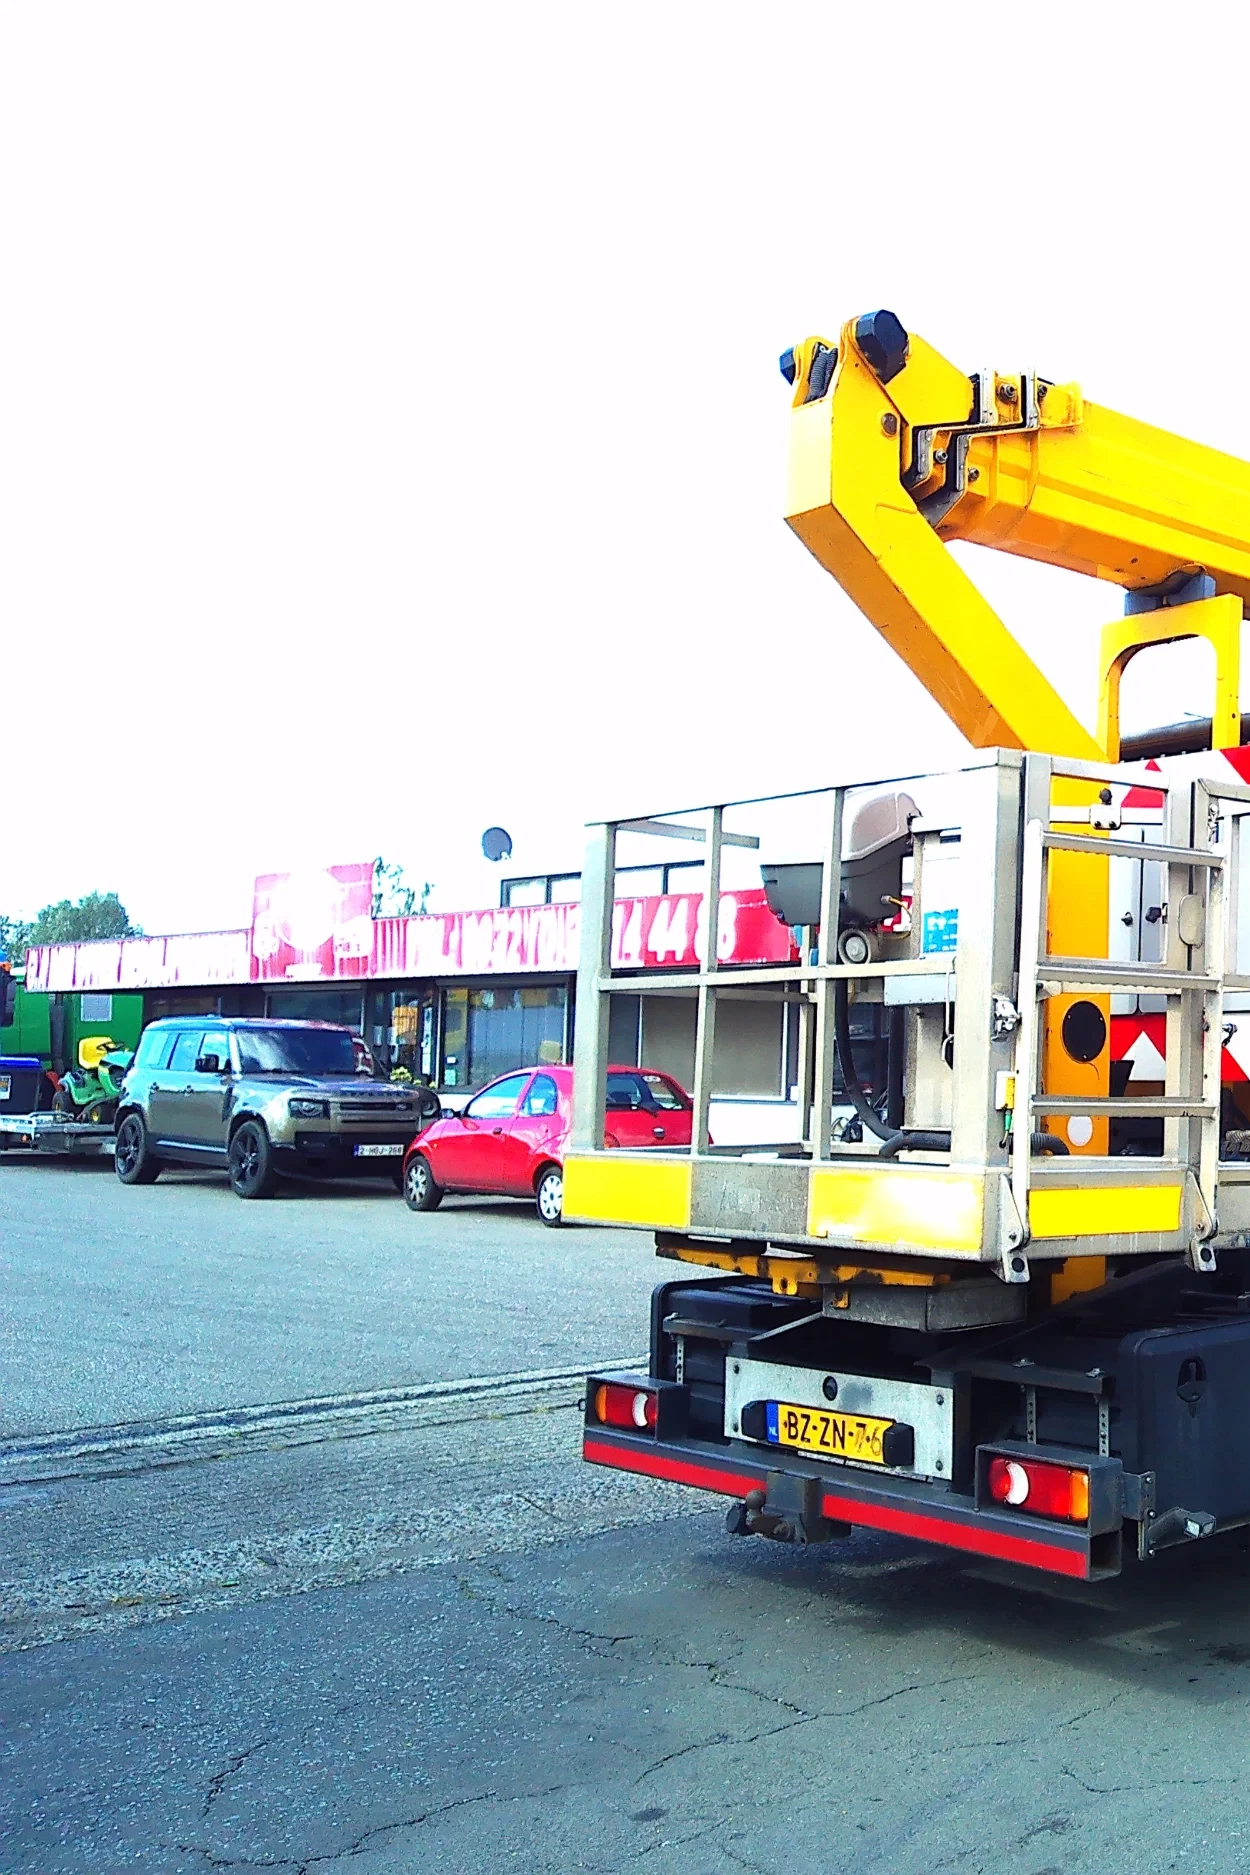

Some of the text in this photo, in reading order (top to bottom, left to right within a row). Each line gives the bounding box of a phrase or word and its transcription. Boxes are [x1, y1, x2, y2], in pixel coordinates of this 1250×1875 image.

[648, 898, 689, 962] 44
[694, 895, 738, 961] 8
[768, 1425, 778, 1437] NL
